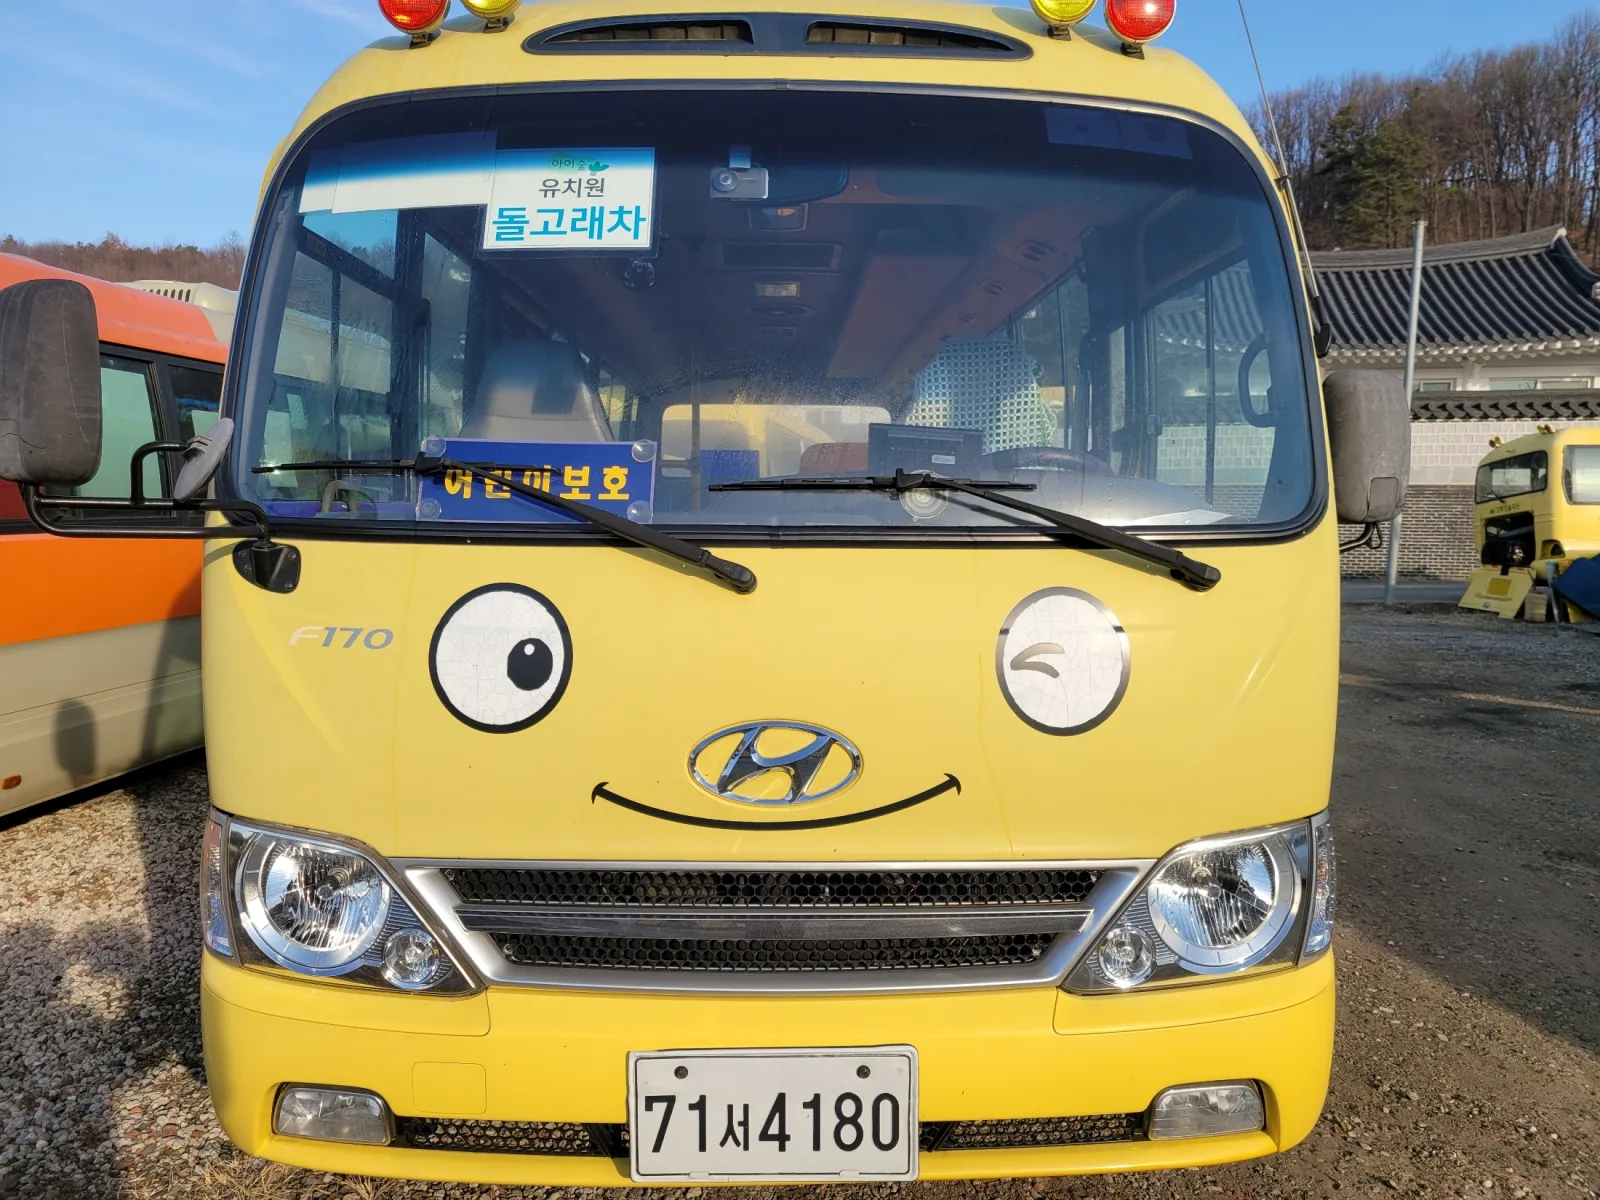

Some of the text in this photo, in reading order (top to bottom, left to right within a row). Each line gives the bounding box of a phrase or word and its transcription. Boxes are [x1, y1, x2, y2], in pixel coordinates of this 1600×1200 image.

[551, 158, 588, 171] 아이숲
[538, 177, 605, 198] 유치원
[492, 205, 646, 242] 돌고래차
[288, 625, 394, 650] F170
[644, 1091, 900, 1153] 71서4180
